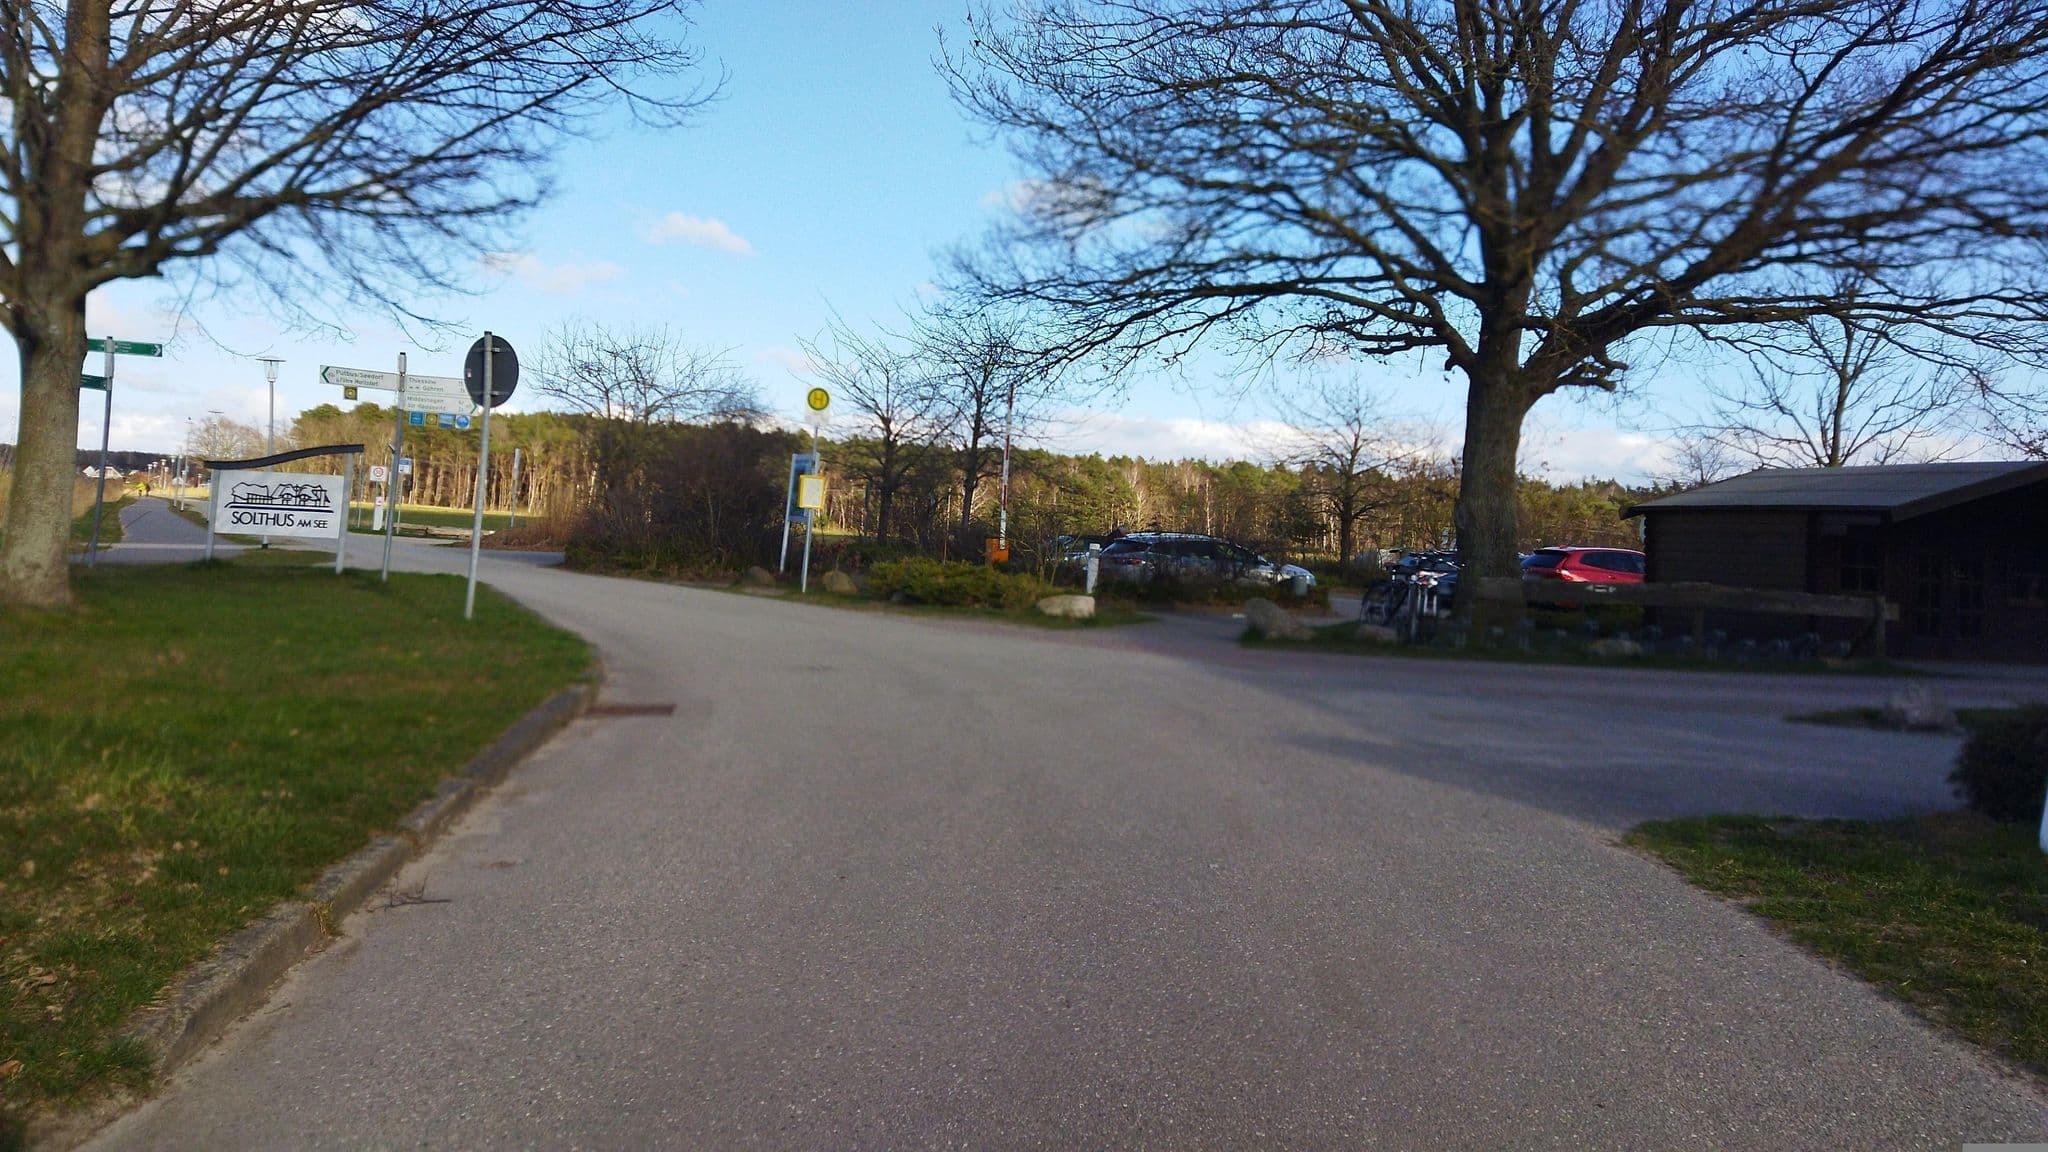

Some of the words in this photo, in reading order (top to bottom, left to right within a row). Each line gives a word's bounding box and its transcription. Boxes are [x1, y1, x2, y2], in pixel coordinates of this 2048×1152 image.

[813, 392, 824, 406] H
[231, 511, 295, 527] SOLTHUS
[297, 519, 312, 528] AM
[313, 520, 328, 529] SEE
